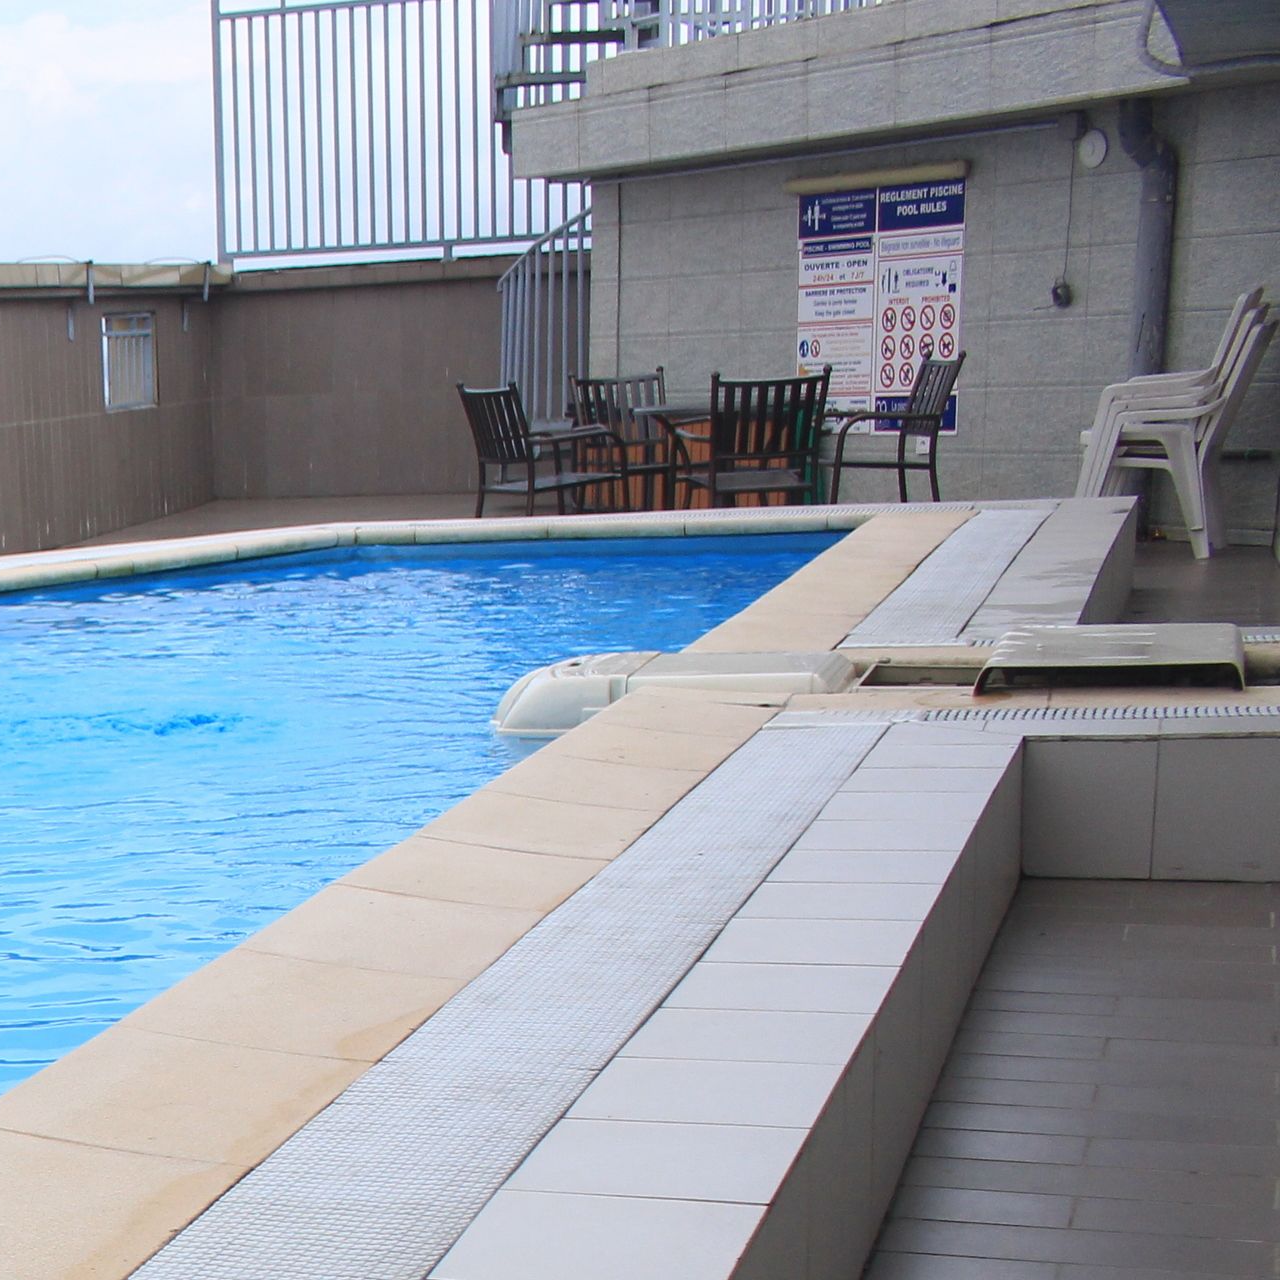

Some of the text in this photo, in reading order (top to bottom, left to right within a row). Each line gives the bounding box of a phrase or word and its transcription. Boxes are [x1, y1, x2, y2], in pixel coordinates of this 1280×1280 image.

[880, 187, 928, 203] REGLEMENT
[930, 183, 963, 198] PISCINE
[896, 201, 947, 217] POOL RULES
[855, 240, 870, 249] POOL
[804, 261, 840, 271] OUVERTE
[846, 259, 868, 268] OPEN
[836, 287, 867, 295] PROTECTION
